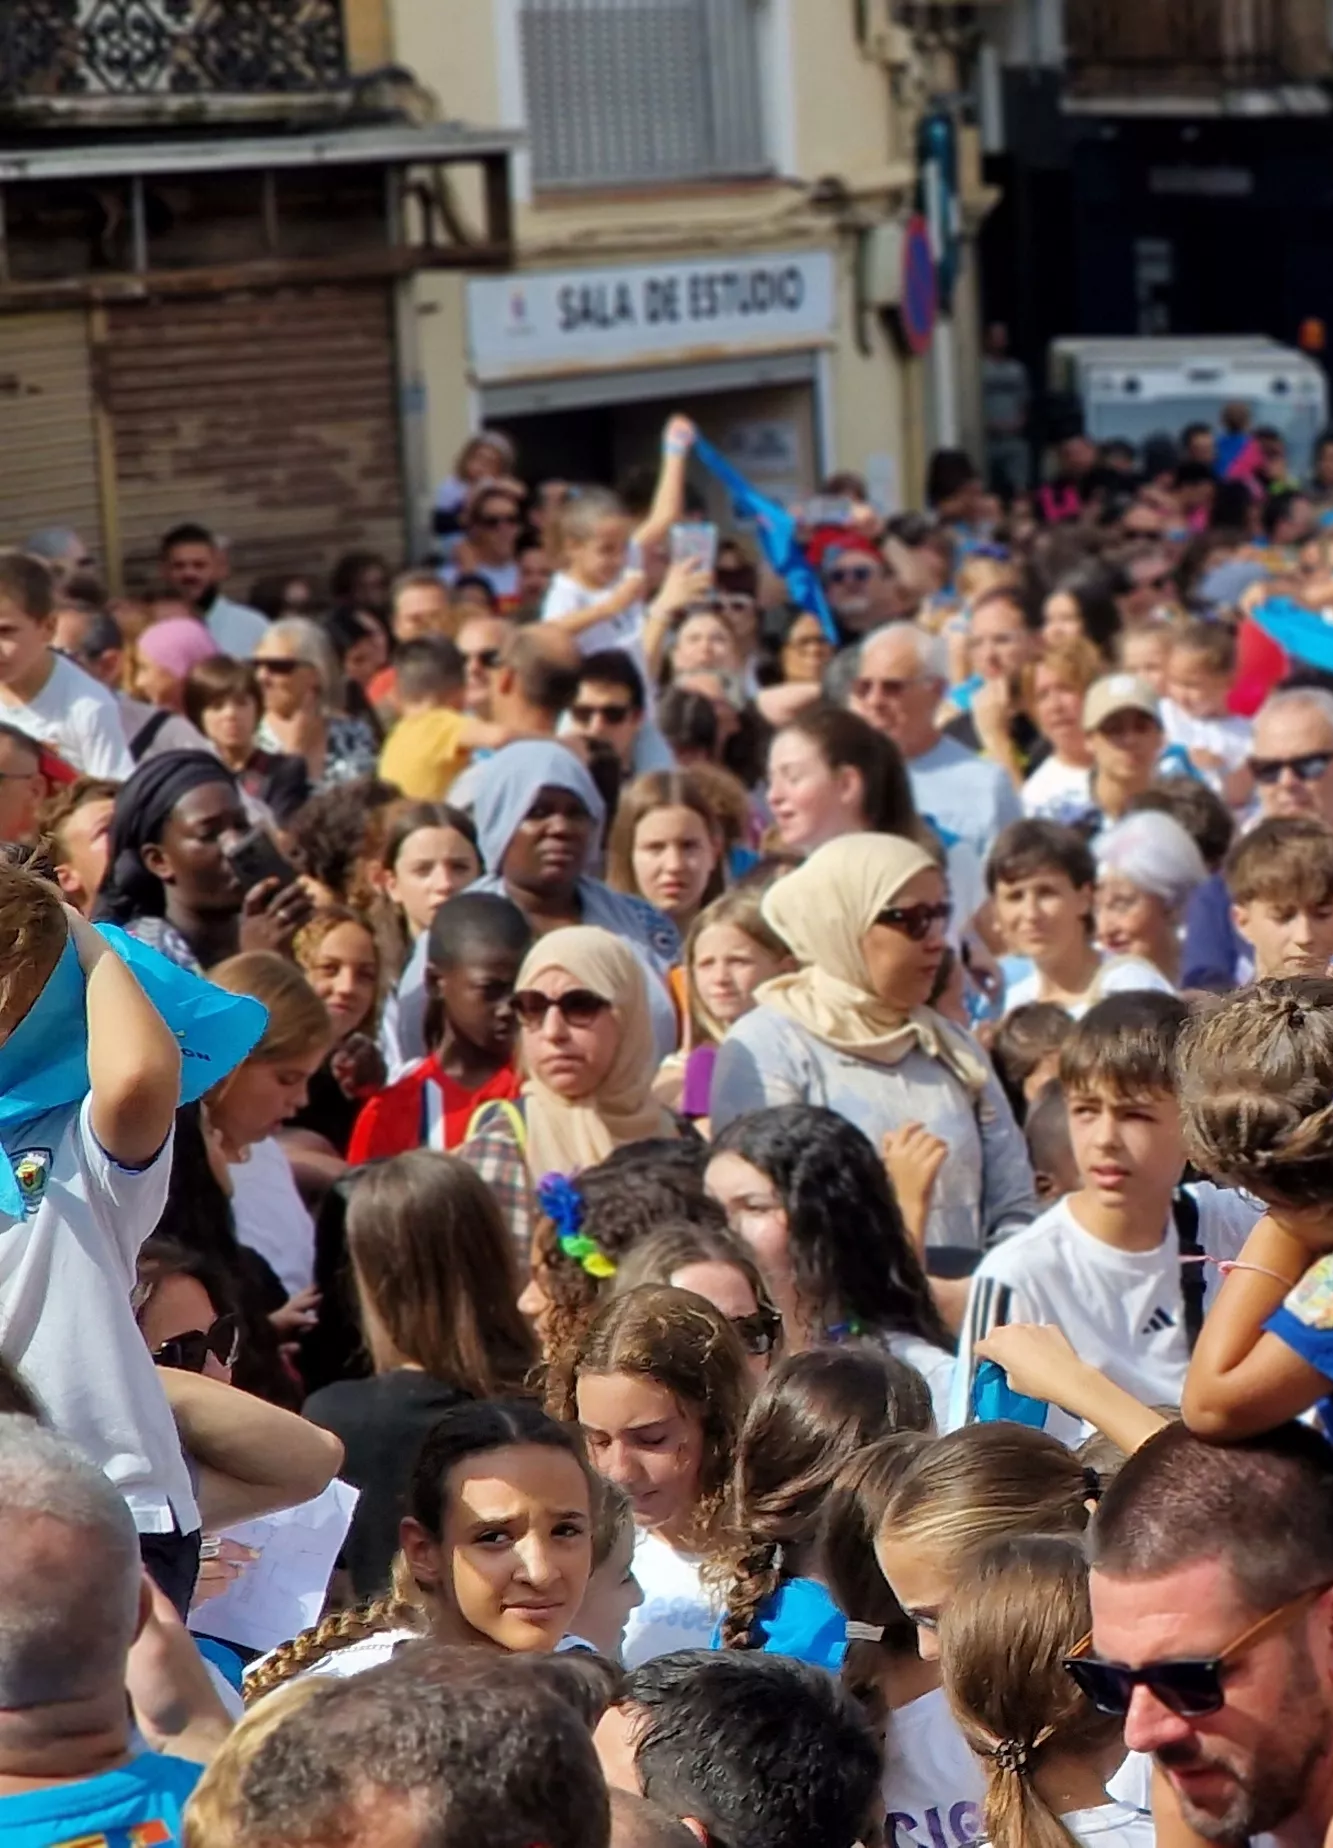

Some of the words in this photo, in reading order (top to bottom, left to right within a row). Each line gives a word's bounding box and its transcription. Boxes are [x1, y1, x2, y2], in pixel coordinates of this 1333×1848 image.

[557, 279, 637, 333] SALA
[643, 275, 680, 325] DE
[687, 264, 805, 322] ESTUDIO
